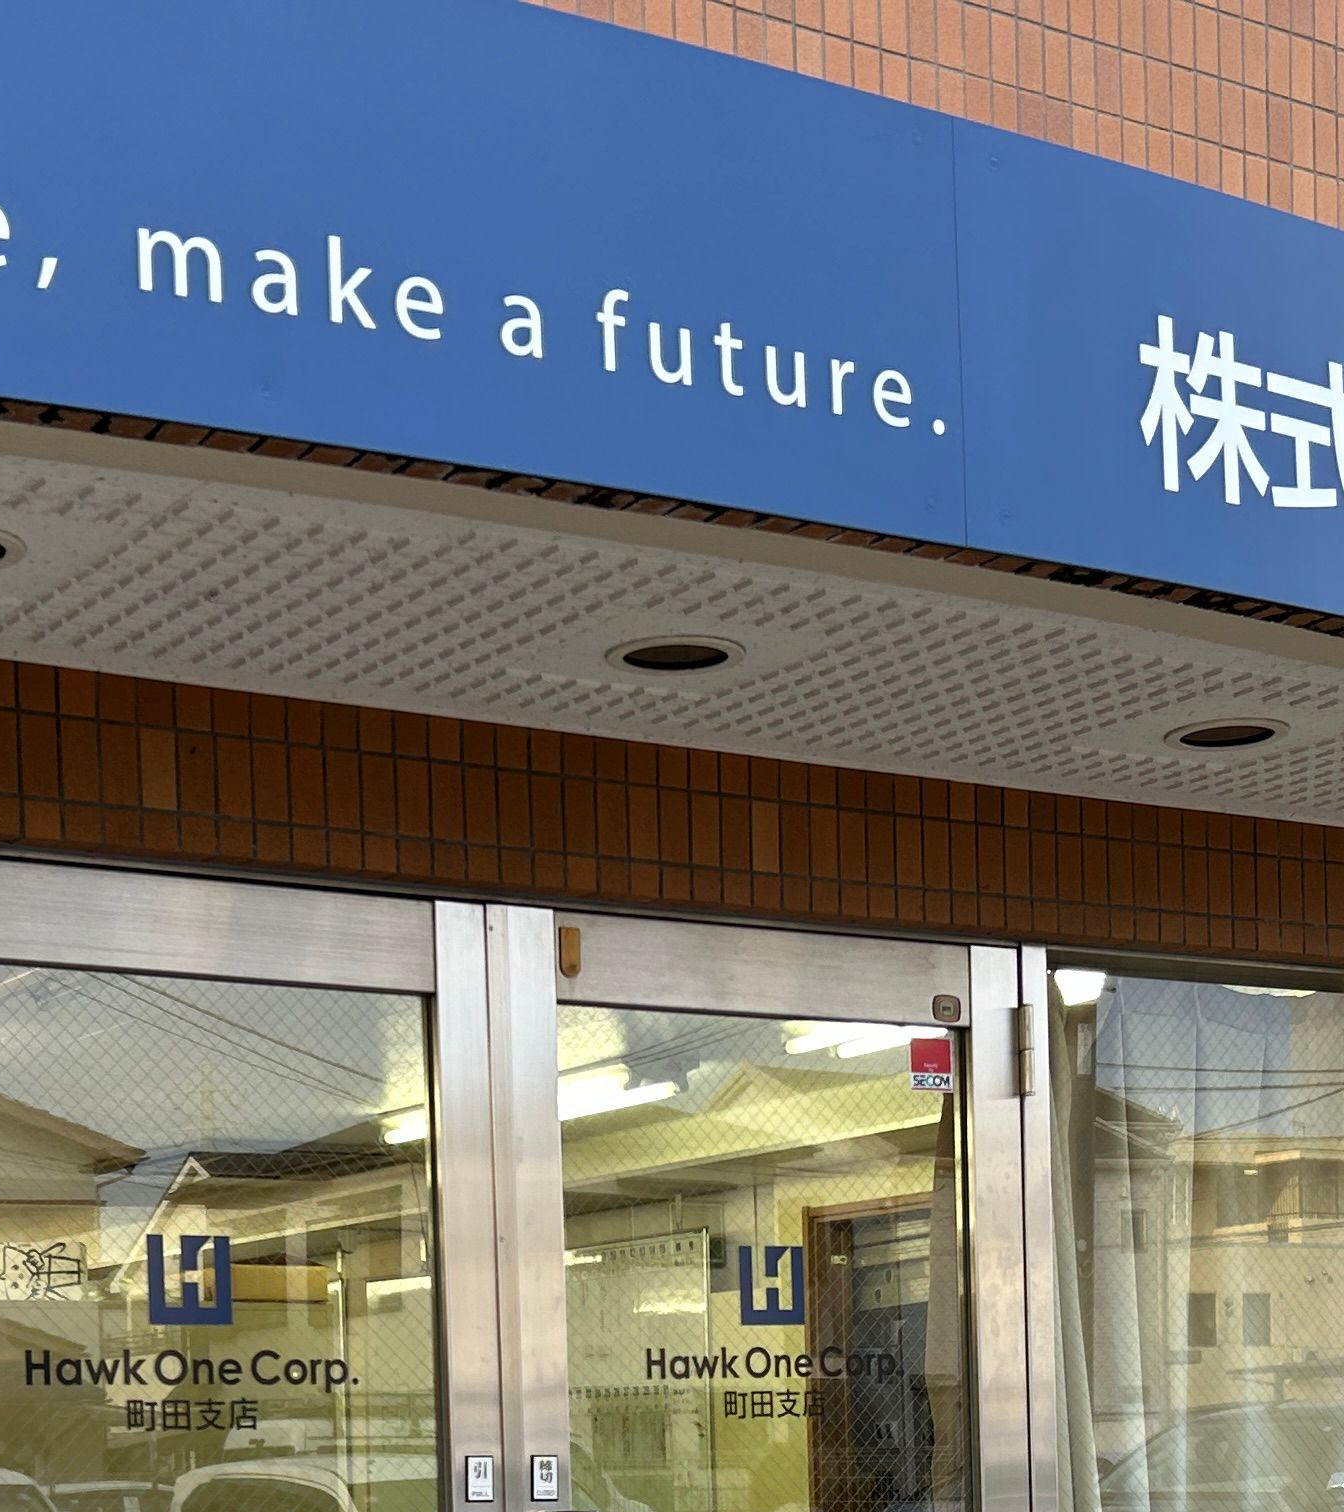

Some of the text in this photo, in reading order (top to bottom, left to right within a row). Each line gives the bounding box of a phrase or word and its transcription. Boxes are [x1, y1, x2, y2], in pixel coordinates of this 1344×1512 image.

[138, 227, 445, 341] make
[500, 295, 544, 360] a
[596, 289, 947, 437] future.
[913, 1074, 950, 1088] SECOM
[25, 1348, 359, 1393] Hawk One Corp.
[645, 1345, 903, 1383] Hawk One Corp.
[125, 1398, 259, 1432] 町田支店
[723, 1389, 826, 1420] 町田支店
[473, 1460, 488, 1480] 引
